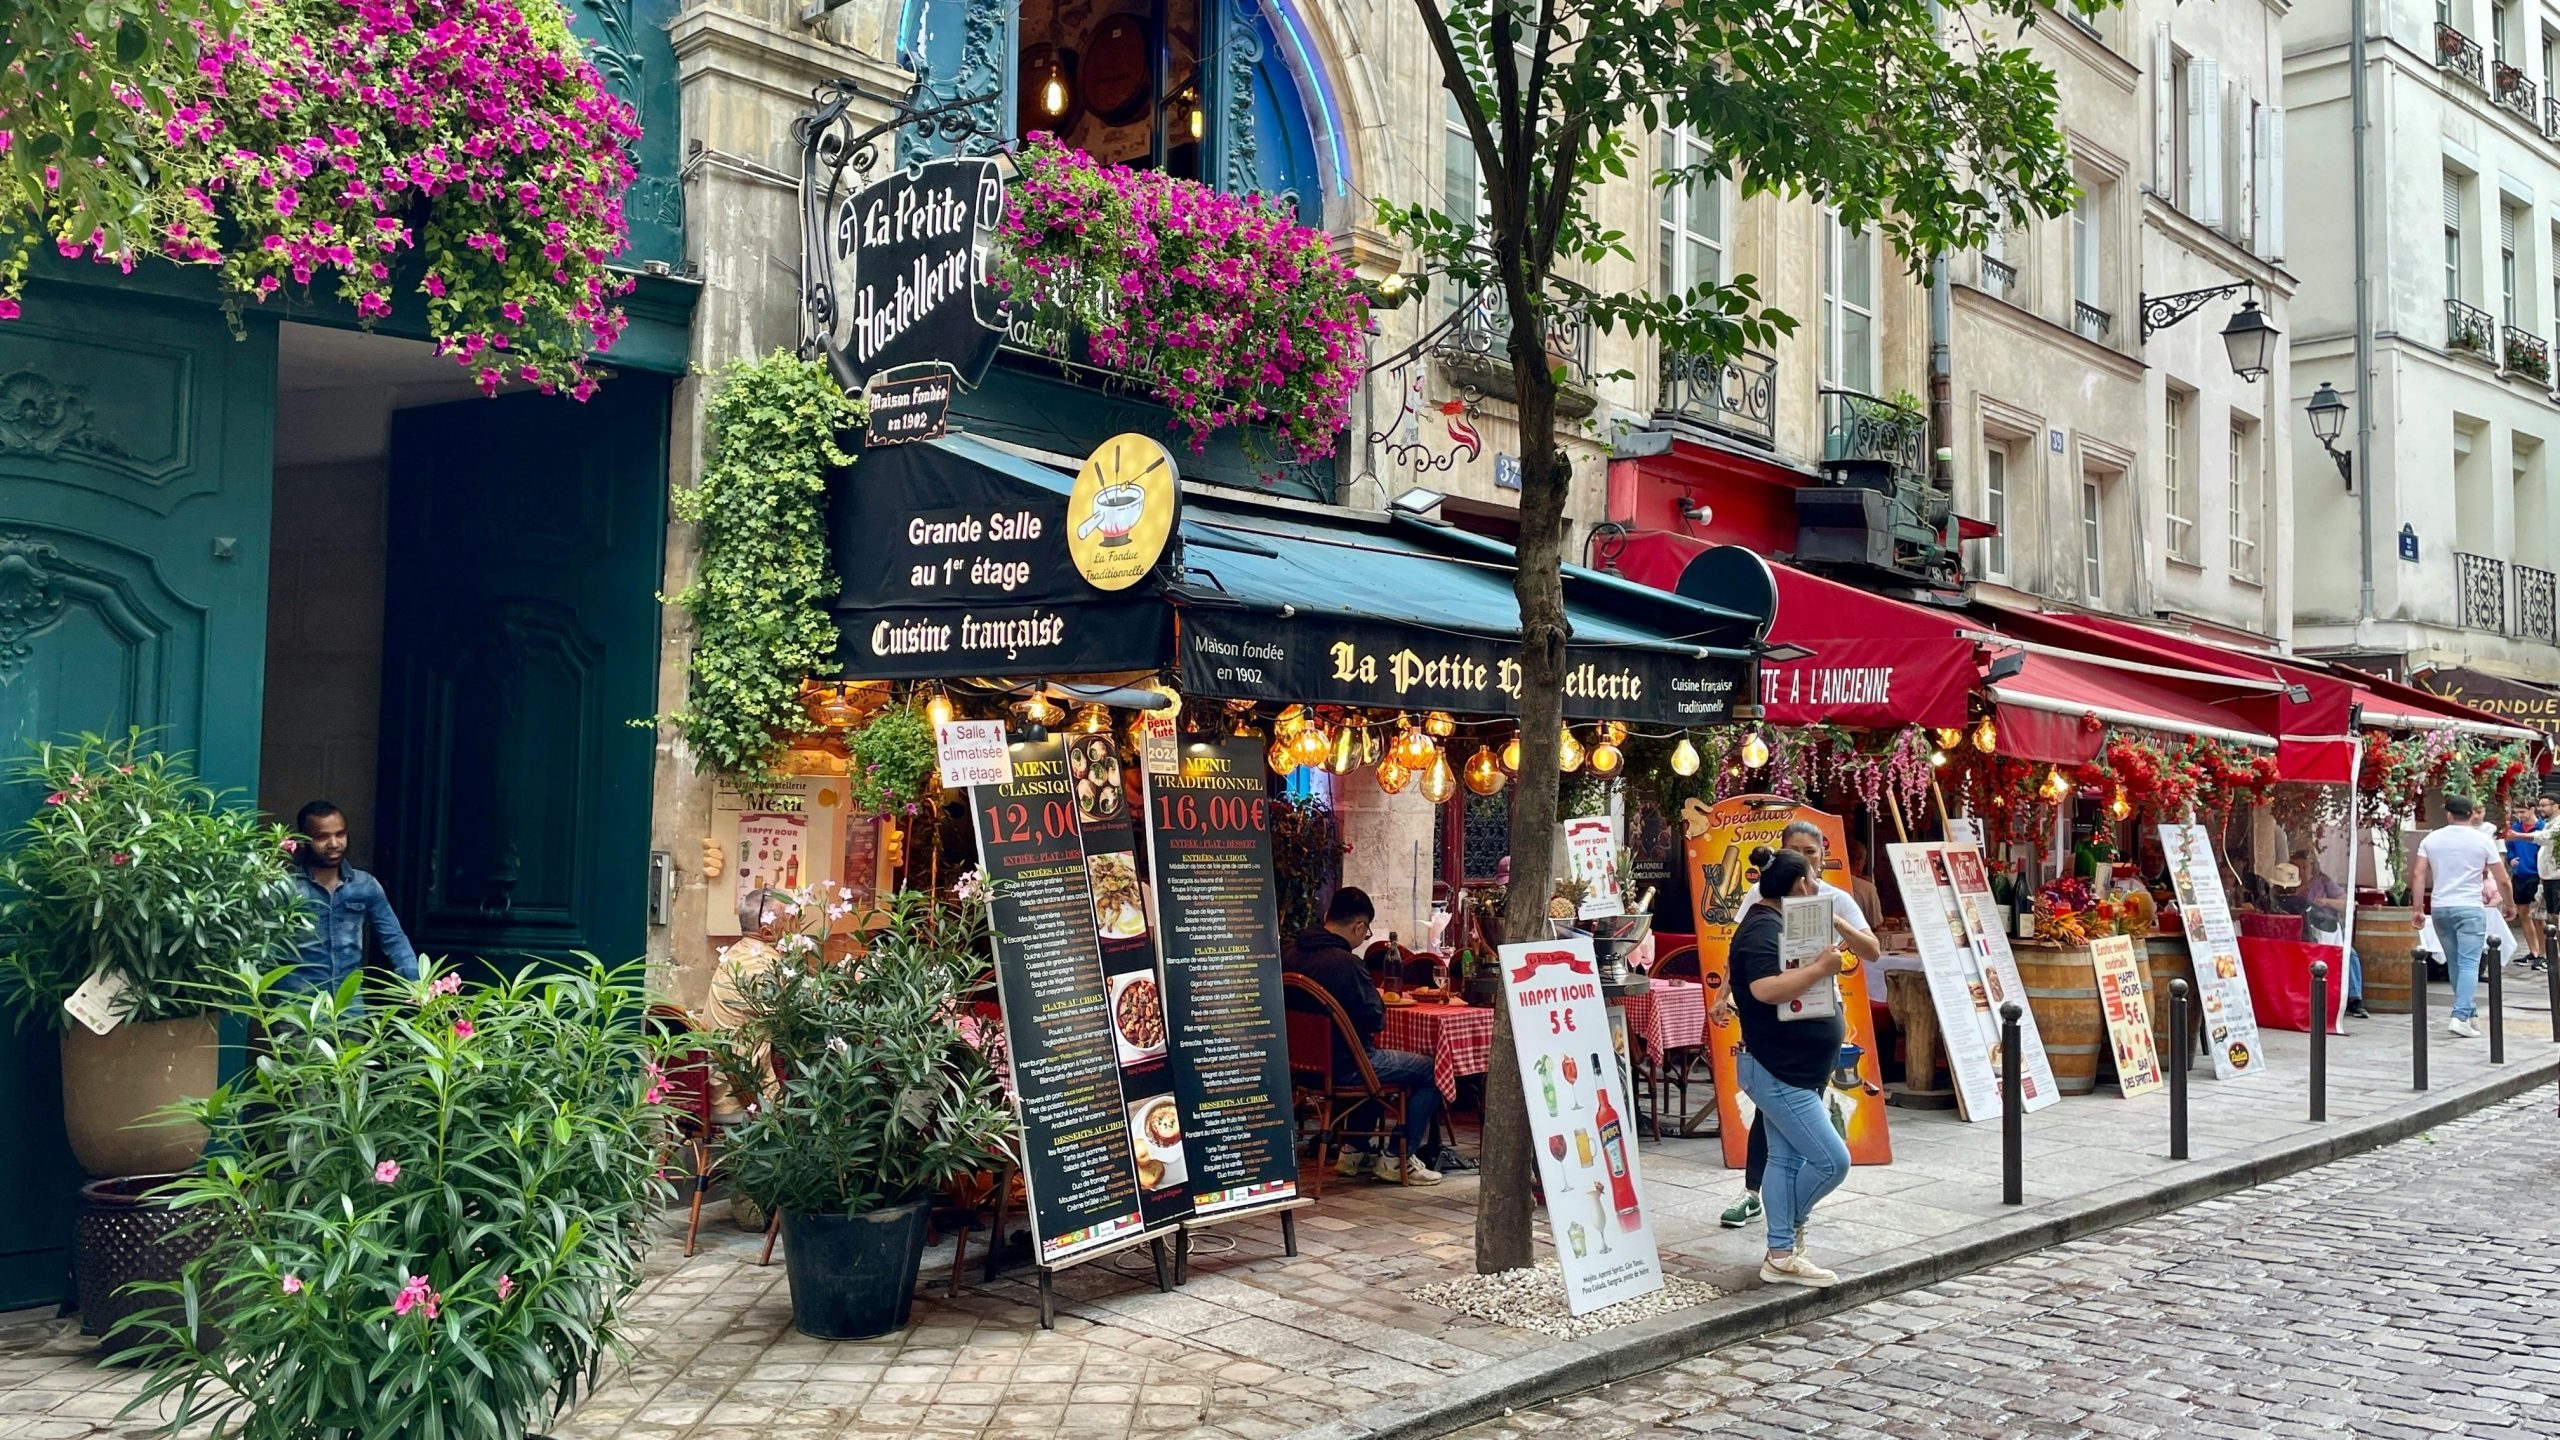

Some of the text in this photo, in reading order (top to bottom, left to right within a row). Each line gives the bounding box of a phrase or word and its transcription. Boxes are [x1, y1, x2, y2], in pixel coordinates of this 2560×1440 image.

[863, 184, 967, 248] La Petite
[855, 248, 967, 363] Hostellerie
[870, 392, 910, 412] Maison
[887, 412, 928, 431] en 1902
[1500, 458, 1520, 484] 37
[908, 511, 1042, 545] Grande Salle
[1093, 549, 1138, 564] La Fondue
[910, 556, 1030, 591] au 1er étage
[1085, 564, 1145, 581] Traditionnelle
[871, 609, 1065, 660] Cuisine française
[1195, 635, 1285, 661] Maison fondée
[1216, 667, 1263, 684] en 1902
[1329, 641, 1643, 701] La Petite Hellerie
[1671, 677, 1733, 694] Cuisine française
[1789, 668, 1800, 704] A
[1810, 667, 1894, 705] L'ANCIENNE
[1678, 698, 1724, 714] traditionnelle
[956, 725, 986, 740] Salle
[1147, 719, 1173, 731] petit
[1152, 726, 1175, 738] futé
[943, 743, 1003, 761] climatisée
[1149, 747, 1178, 760] 2024
[1013, 760, 1064, 778] MENU
[1185, 757, 1231, 773] MENU
[951, 766, 1003, 782] à l'étage
[1154, 775, 1263, 791] TRADITIONNEL
[1156, 794, 1266, 836] 16,00€
[747, 827, 798, 837] HAPPY HOUR
[762, 837, 769, 846] 5
[1574, 837, 1607, 846] HAPPY HOUR
[2095, 940, 2130, 956] Exotic sweet
[2105, 956, 2128, 971] cocktails
[2118, 970, 2136, 984] HAPPY
[1519, 983, 1595, 1007] HAPPY HOUR
[2121, 984, 2141, 998] HOURS
[1042, 1001, 1067, 1013] PLATS
[1079, 993, 1104, 1004] CHOIX
[1550, 1007, 1576, 1035] 5 €
[2125, 1002, 2142, 1026] 5€
[2137, 1058, 2149, 1072] BAR
[2124, 1072, 2152, 1090] DES SPRITZ
[1199, 1100, 1235, 1111] DESSERTS
[1246, 1094, 1269, 1104] CHOIX
[1053, 1129, 1093, 1146] DESSERTS
